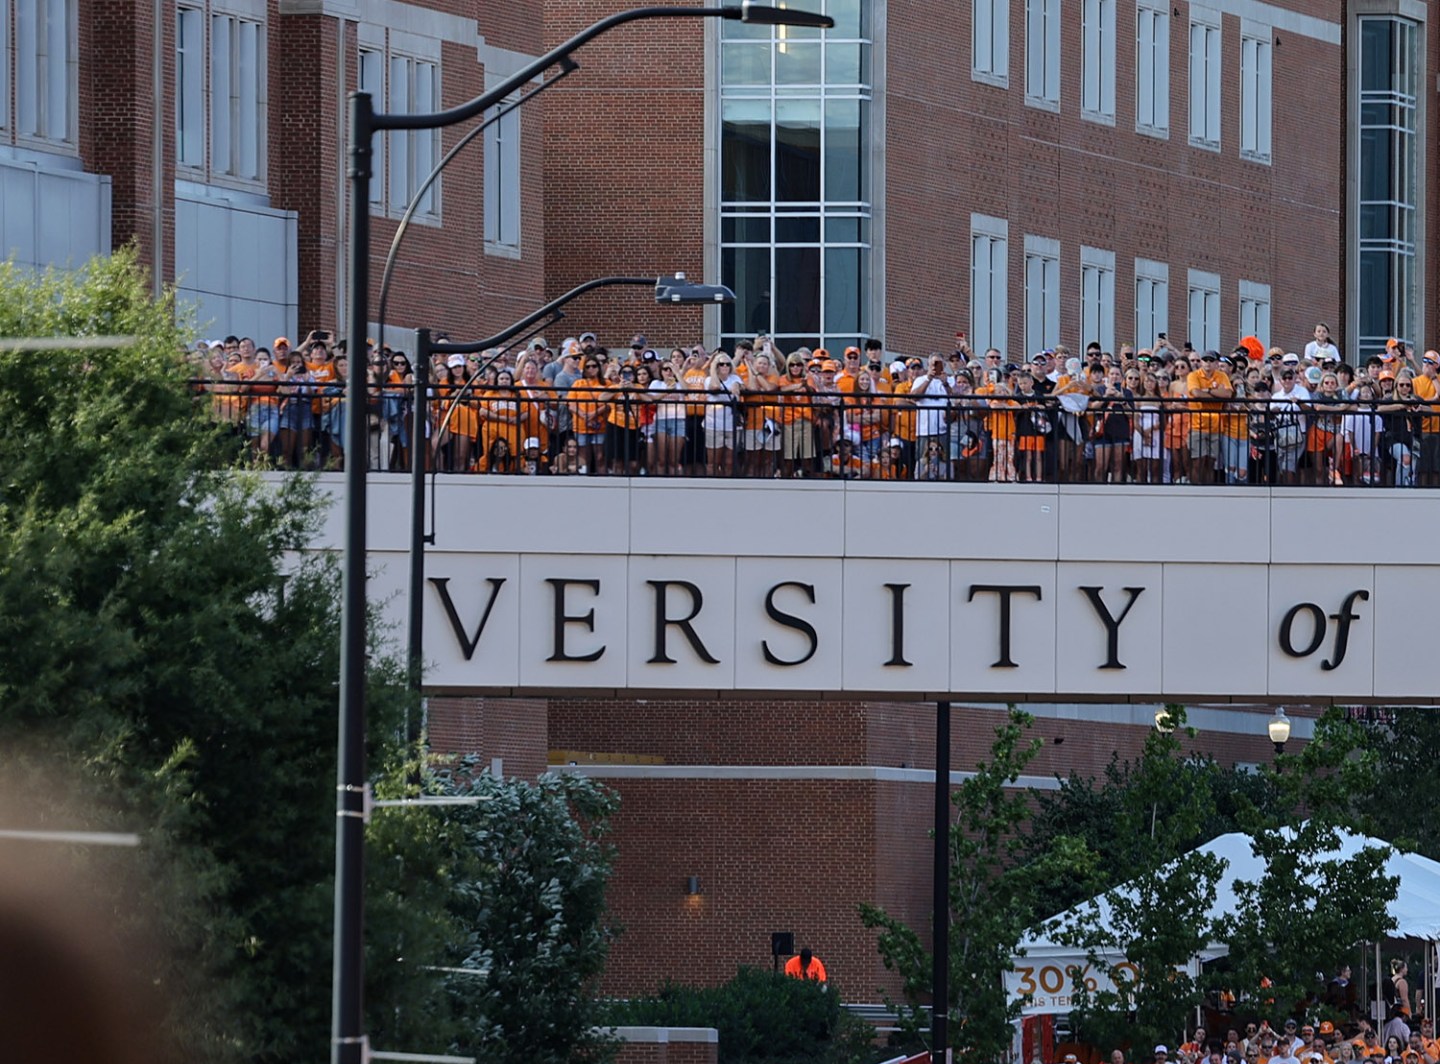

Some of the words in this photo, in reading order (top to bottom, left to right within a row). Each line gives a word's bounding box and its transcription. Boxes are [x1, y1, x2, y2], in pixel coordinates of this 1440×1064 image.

[276, 573, 1145, 670] VERSITY
[1278, 594, 1371, 672] of
[1014, 964, 1098, 995] 30%
